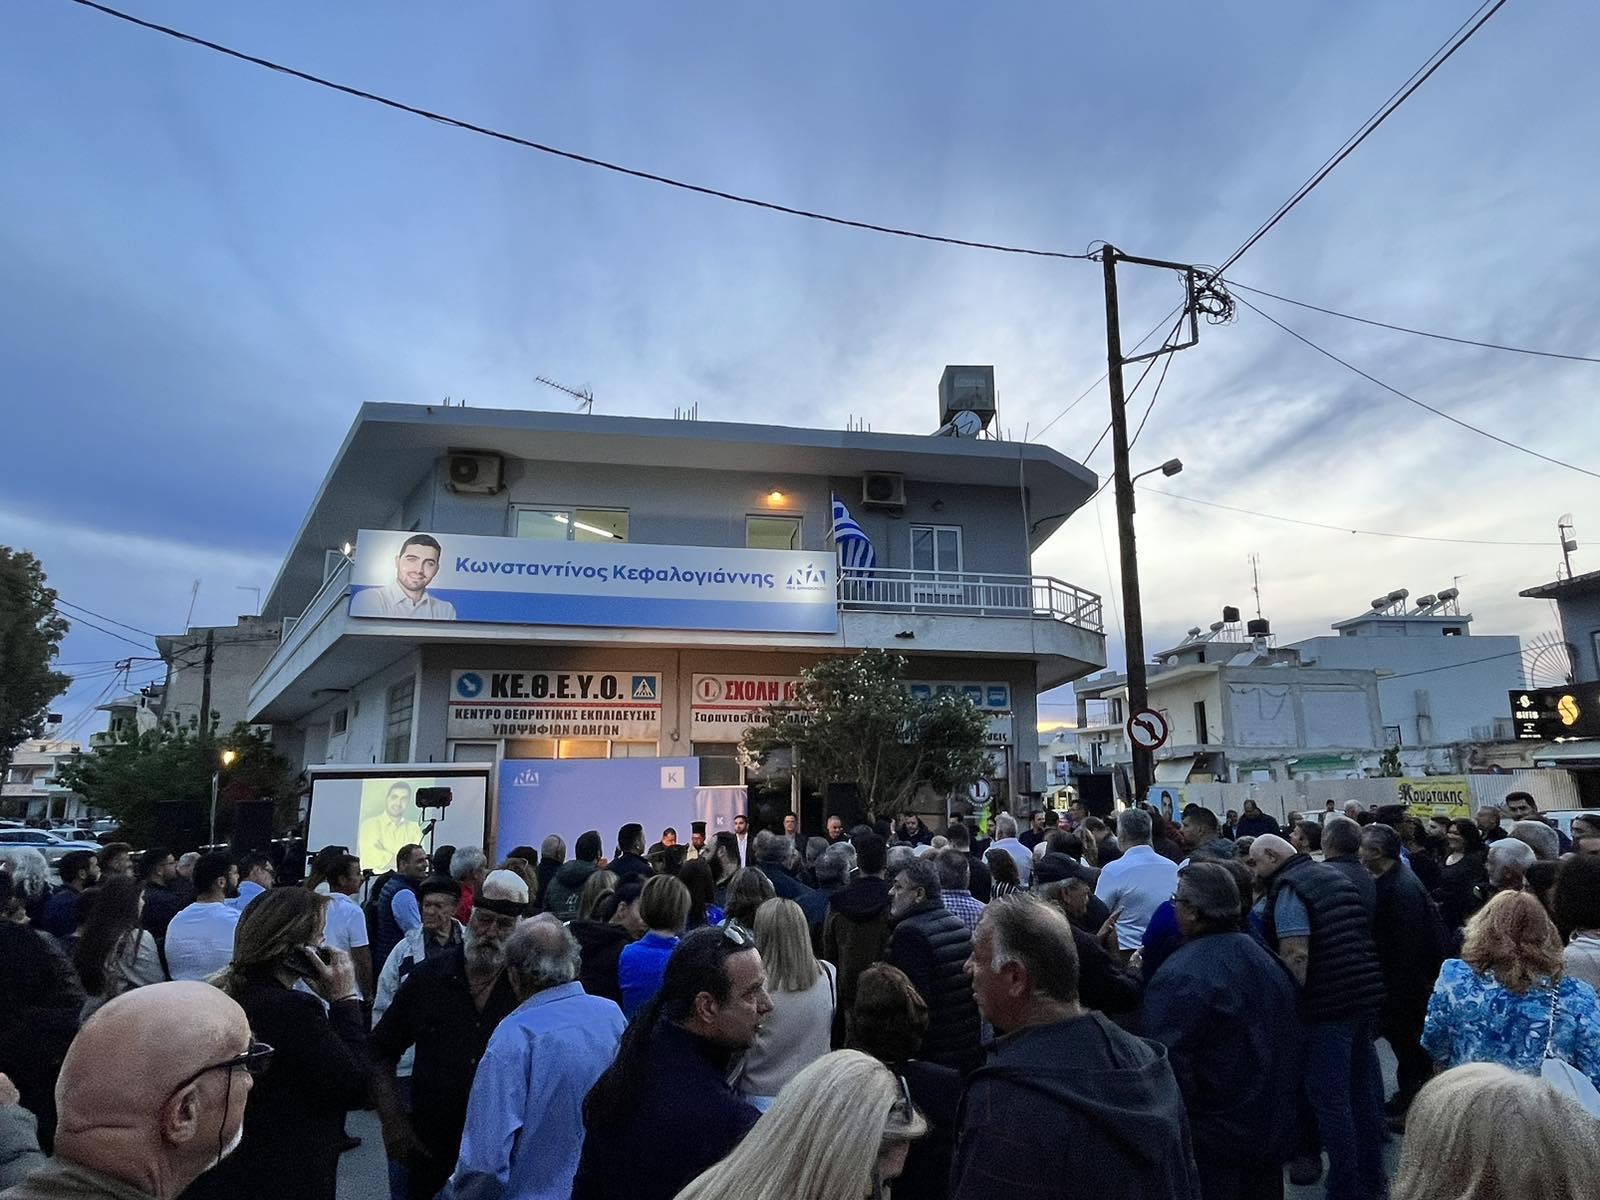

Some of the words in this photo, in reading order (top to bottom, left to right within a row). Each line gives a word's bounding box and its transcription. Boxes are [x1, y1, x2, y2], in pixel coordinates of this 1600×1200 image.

[455, 556, 608, 582] Κωνσταντίνος
[613, 564, 775, 588] Κεφαλογιάννης
[724, 681, 779, 701] ΣΧΟΛΗ
[455, 708, 500, 720] ΚΕΝΤΡΟ
[504, 709, 578, 721] ΘΕΩΡΗΤΙΚΗΣ
[580, 709, 656, 721] ΕΚΠΑΙΔΕΥΣΗΣ
[492, 723, 570, 735] ΥΠΟΨΗΦΙΩΝ
[573, 724, 619, 736] ΟΔΗΓΩΝ
